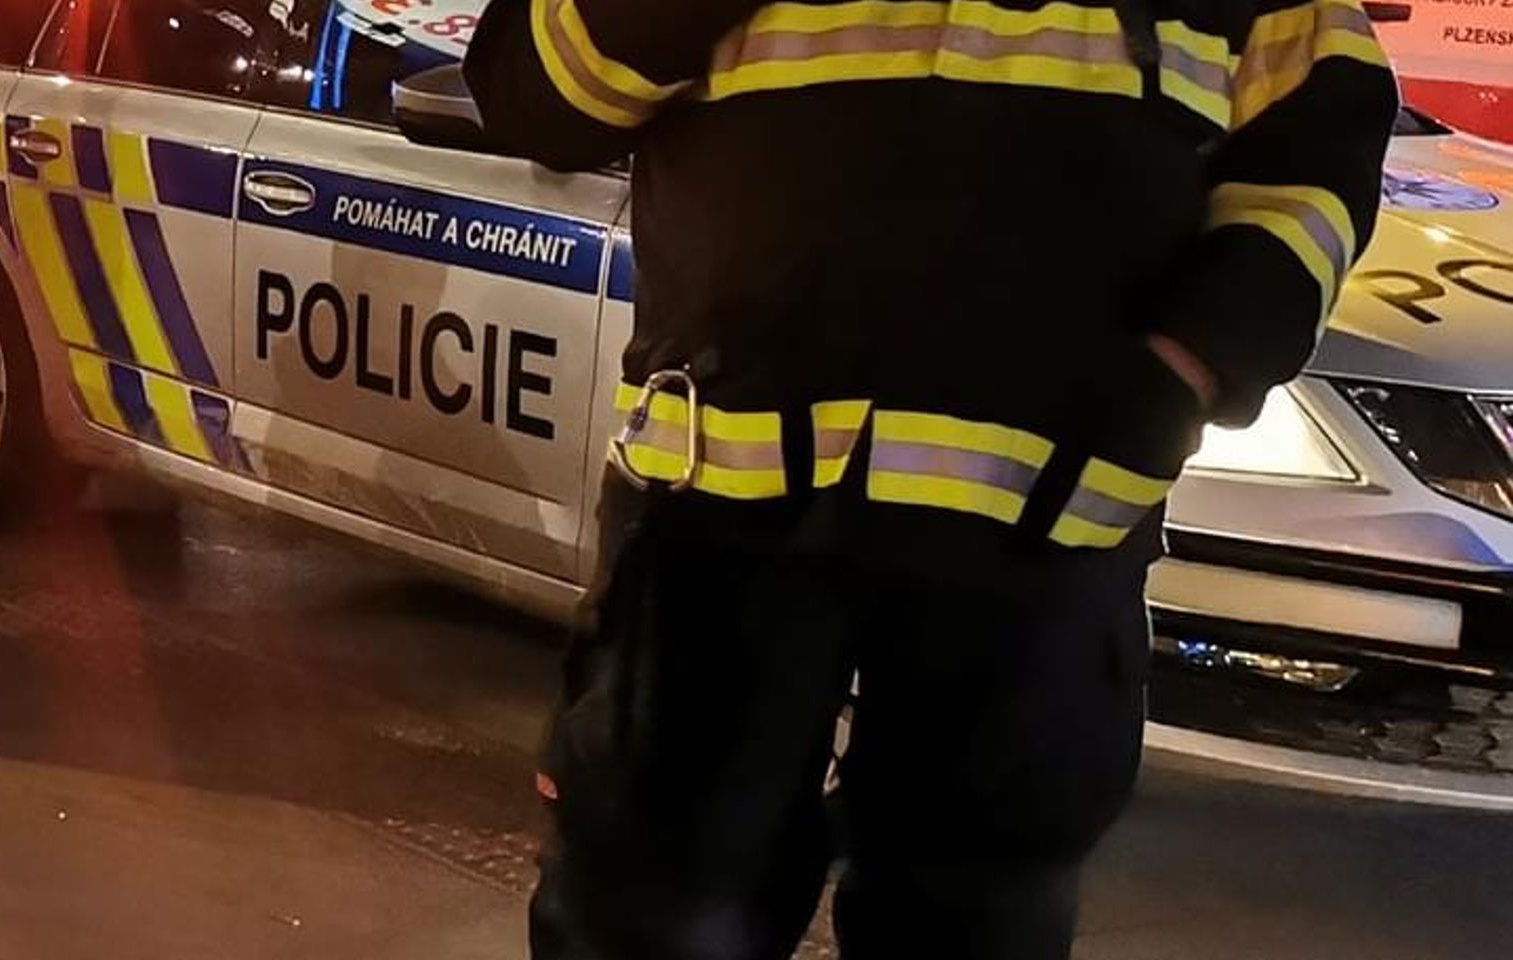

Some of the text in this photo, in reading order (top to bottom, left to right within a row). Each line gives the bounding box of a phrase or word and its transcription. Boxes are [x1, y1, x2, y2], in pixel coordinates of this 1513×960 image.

[333, 196, 578, 268] POMÁHAT A CHRÁNIT
[256, 268, 559, 441] POLICIE
